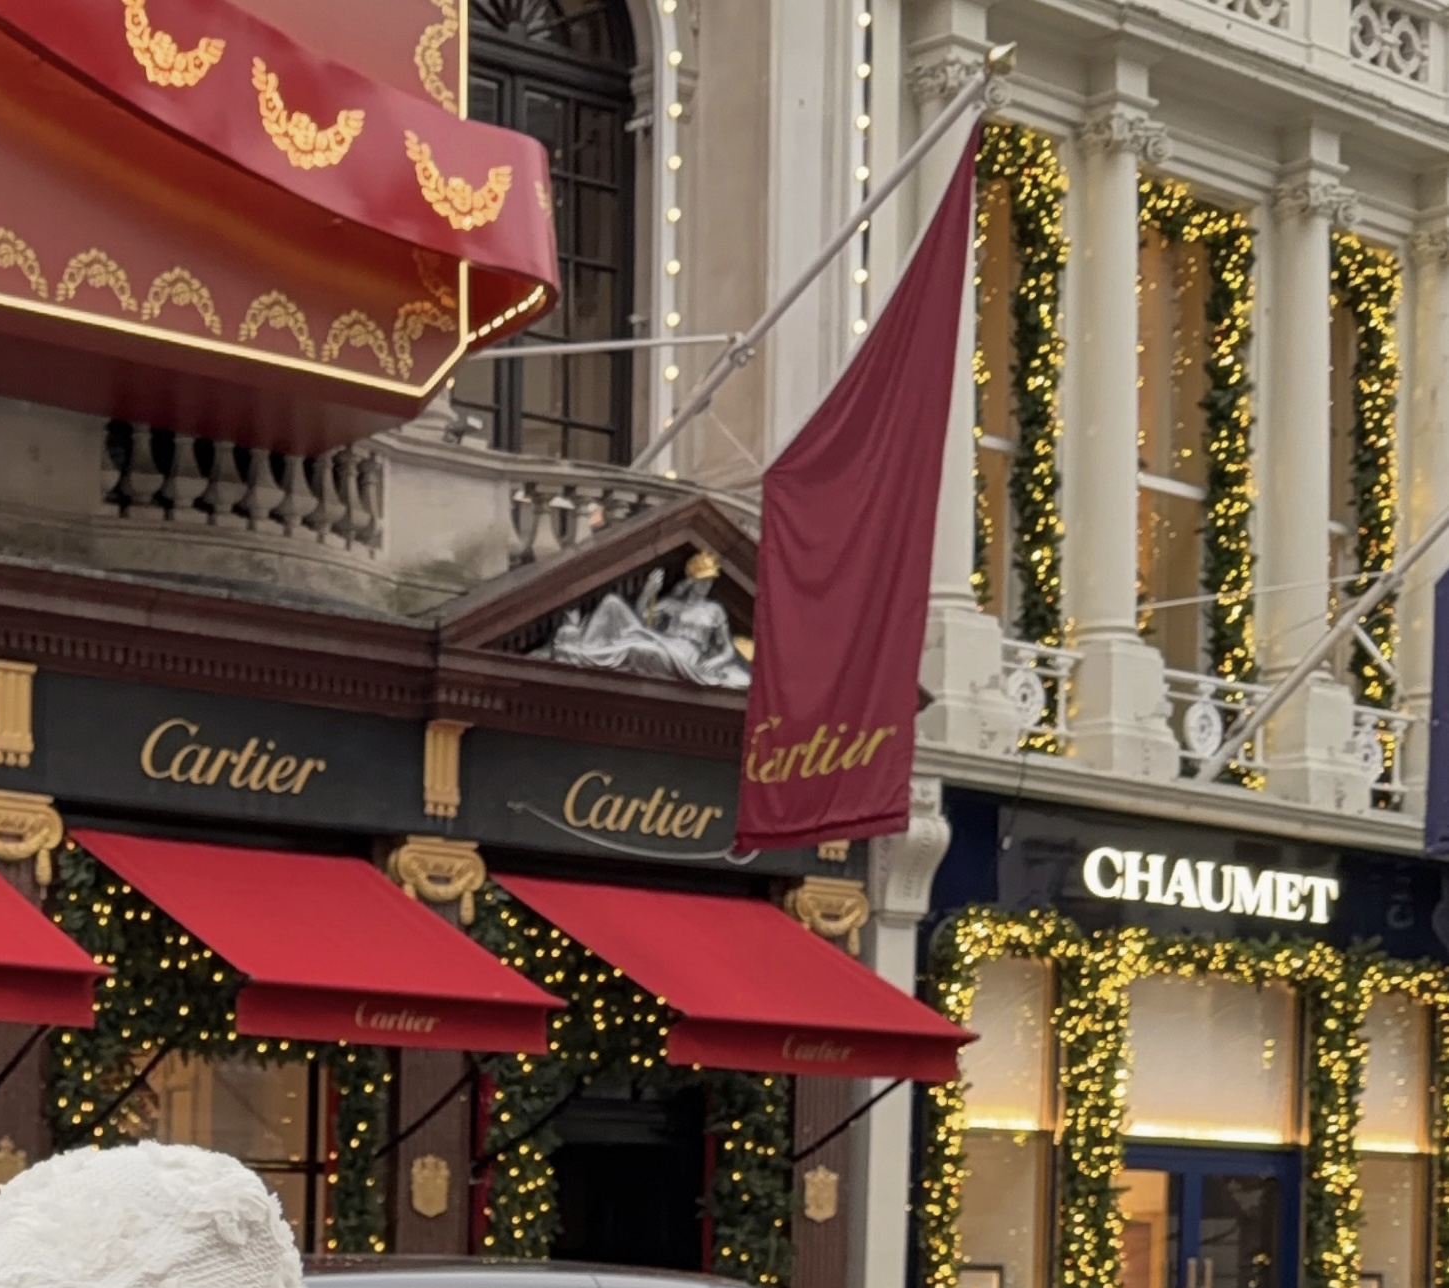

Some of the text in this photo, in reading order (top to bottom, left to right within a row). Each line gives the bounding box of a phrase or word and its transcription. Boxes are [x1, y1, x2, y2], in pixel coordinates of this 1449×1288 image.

[140, 718, 326, 795] Cartier
[563, 770, 723, 840] Cartier
[1083, 846, 1339, 925] CHAUMET
[355, 1000, 441, 1034] Cartier
